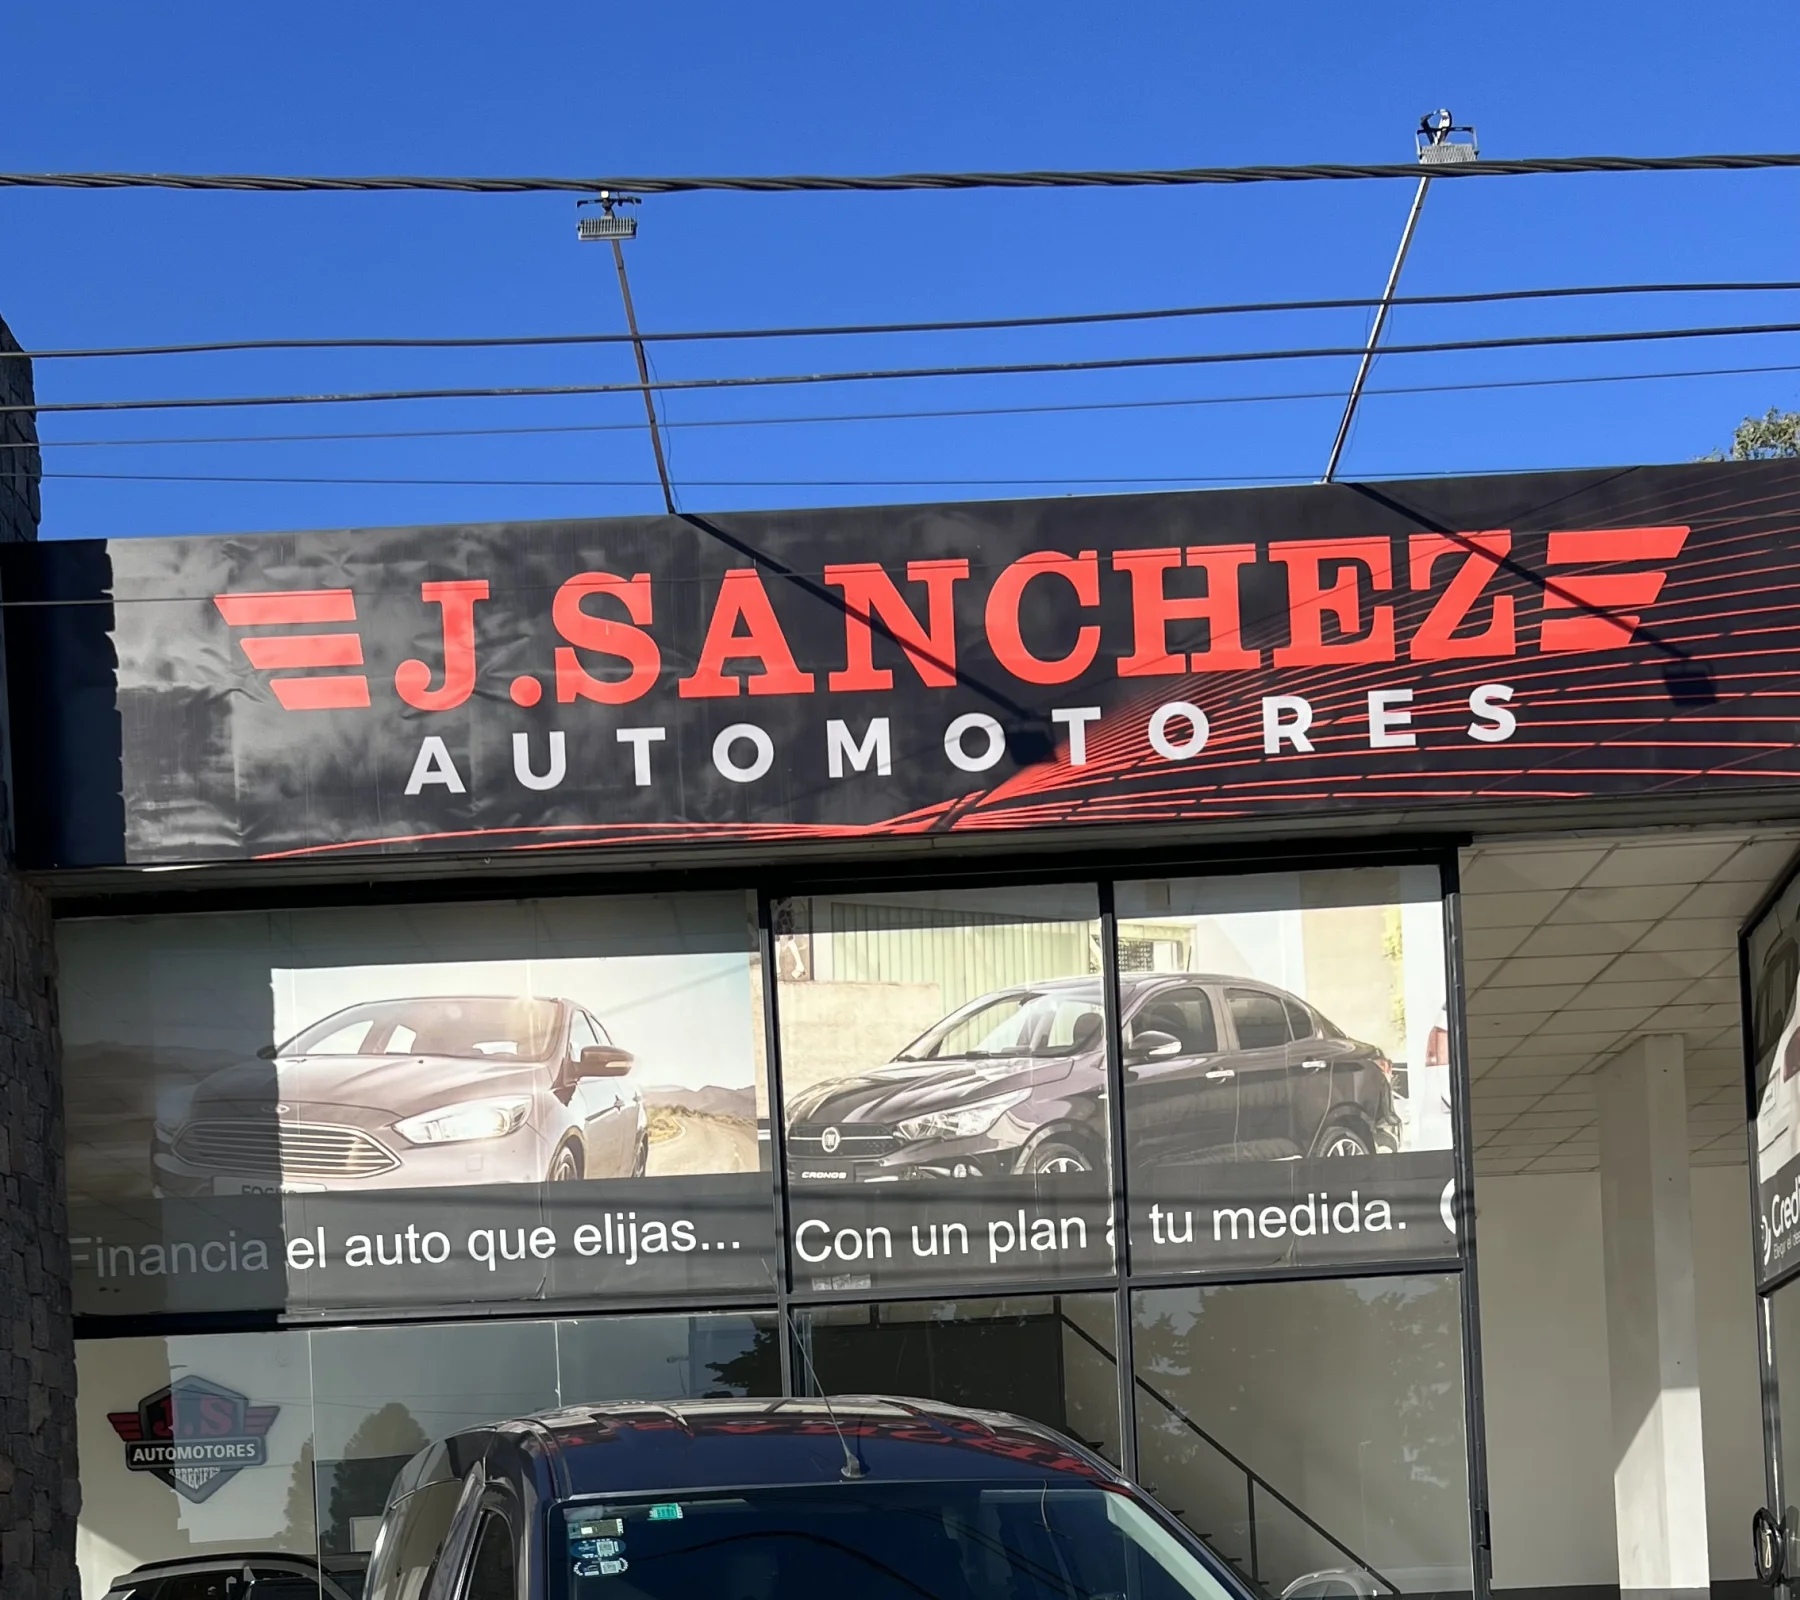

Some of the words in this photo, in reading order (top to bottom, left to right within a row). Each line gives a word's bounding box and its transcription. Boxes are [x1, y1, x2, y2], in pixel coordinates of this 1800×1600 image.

[394, 533, 1520, 712] J.SANCHEZ
[403, 682, 1522, 796] AUTOMOTORES
[801, 1171, 847, 1180] CRONOS
[285, 1226, 326, 1270] el
[345, 1223, 451, 1267] auto
[467, 1226, 556, 1272] que
[573, 1211, 742, 1266] elijas...
[794, 1219, 893, 1263] Con
[911, 1223, 969, 1257] un
[988, 1209, 1087, 1264] plan
[1148, 1203, 1193, 1244] tu
[1213, 1190, 1408, 1241] medida.
[152, 1397, 233, 1437] J.S
[132, 1443, 256, 1462] AUTOMOTORES
[168, 1466, 221, 1490] ARRECIFES
